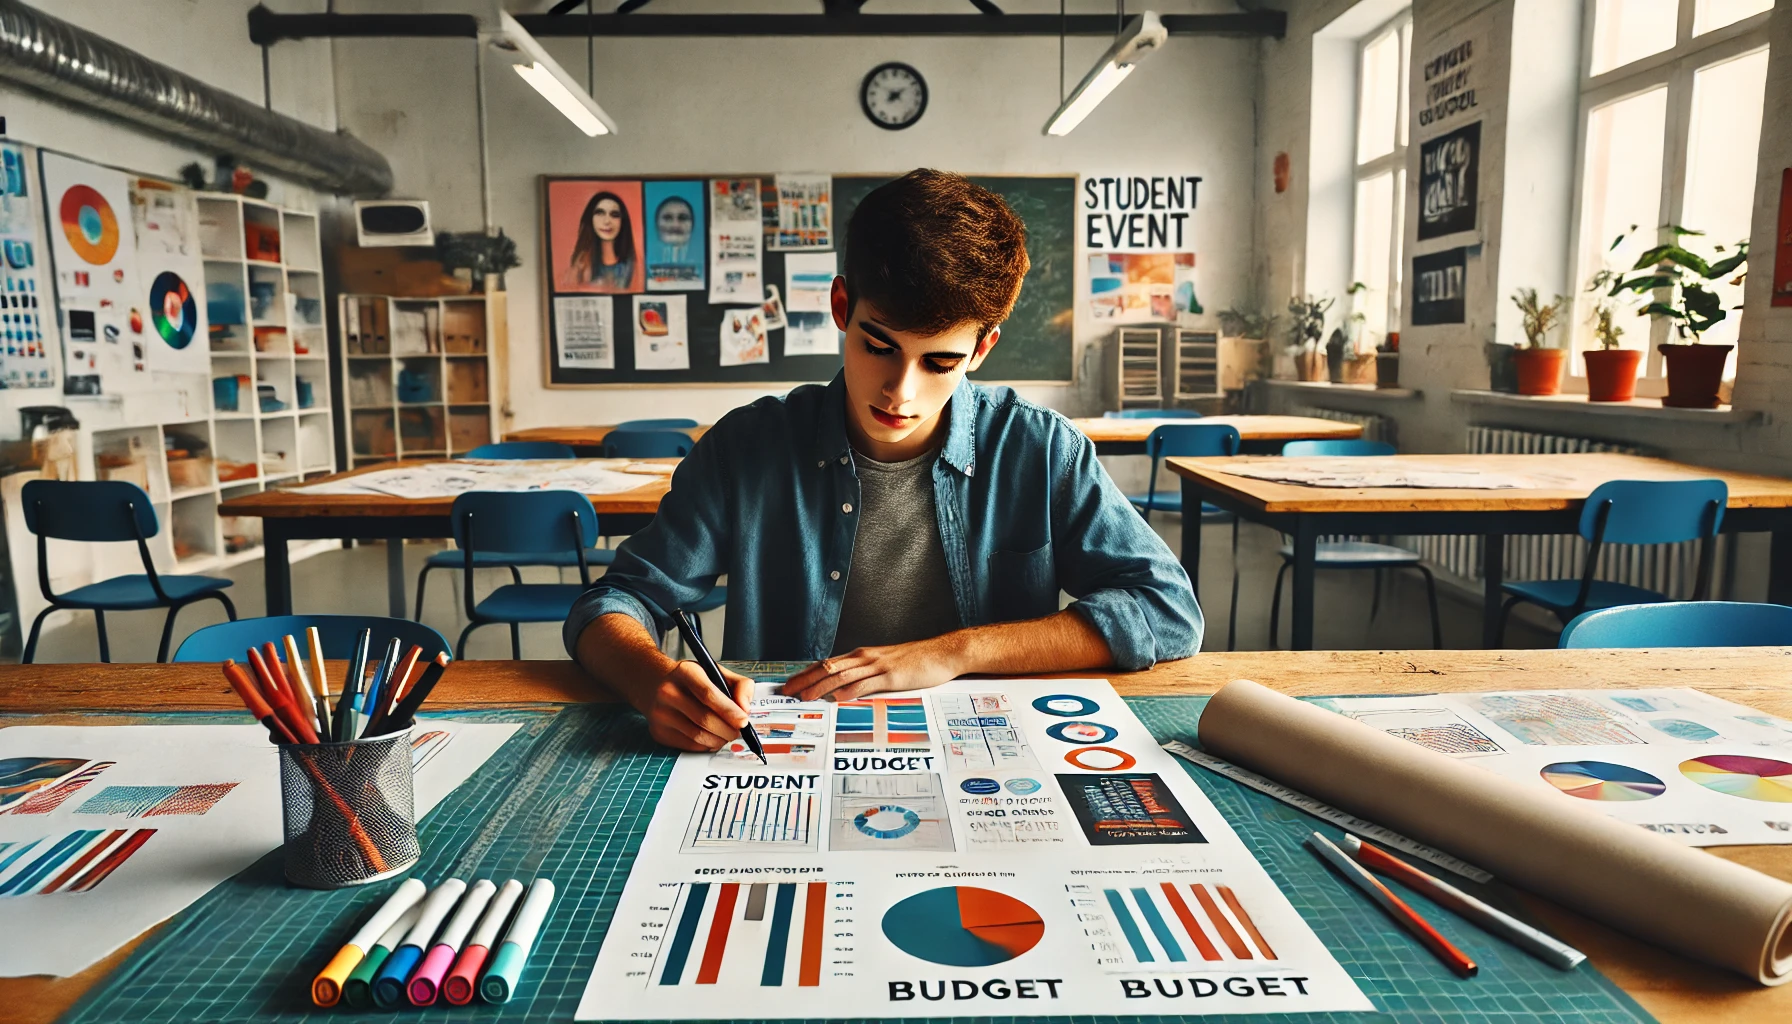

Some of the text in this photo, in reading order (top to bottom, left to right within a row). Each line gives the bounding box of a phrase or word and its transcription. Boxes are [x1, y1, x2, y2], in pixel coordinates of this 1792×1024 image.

[1085, 176, 1203, 210] STUDENT
[1087, 212, 1190, 248] EVENT
[833, 756, 935, 771] BUDGET
[702, 774, 821, 790] STUDENT
[888, 978, 1063, 1001] BUDGET
[1119, 976, 1310, 998] BUDGET
